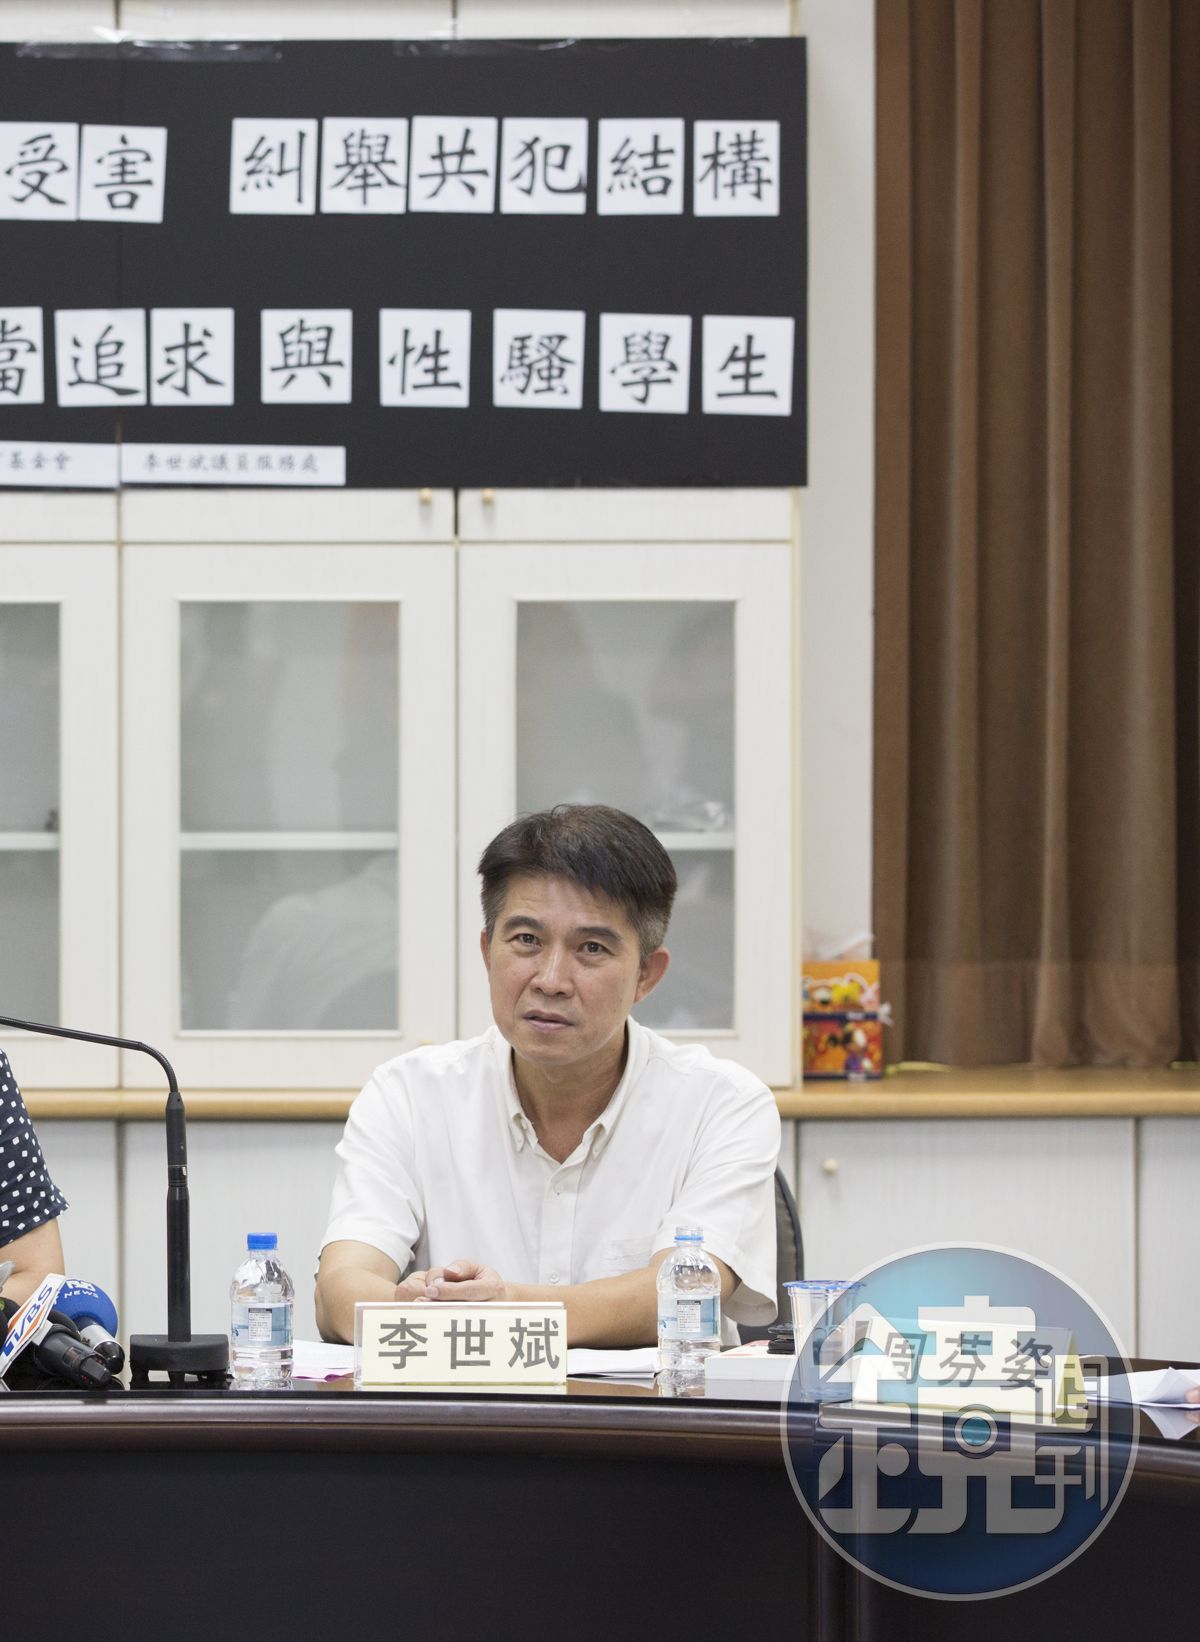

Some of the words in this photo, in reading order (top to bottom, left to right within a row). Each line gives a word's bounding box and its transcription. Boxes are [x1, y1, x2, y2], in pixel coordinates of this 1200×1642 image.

[239, 127, 773, 206] 糾舉共犯結構
[64, 1290, 99, 1299] NEWS
[378, 1316, 561, 1370] 李世斌
[885, 1332, 1053, 1393] 周芬姿
